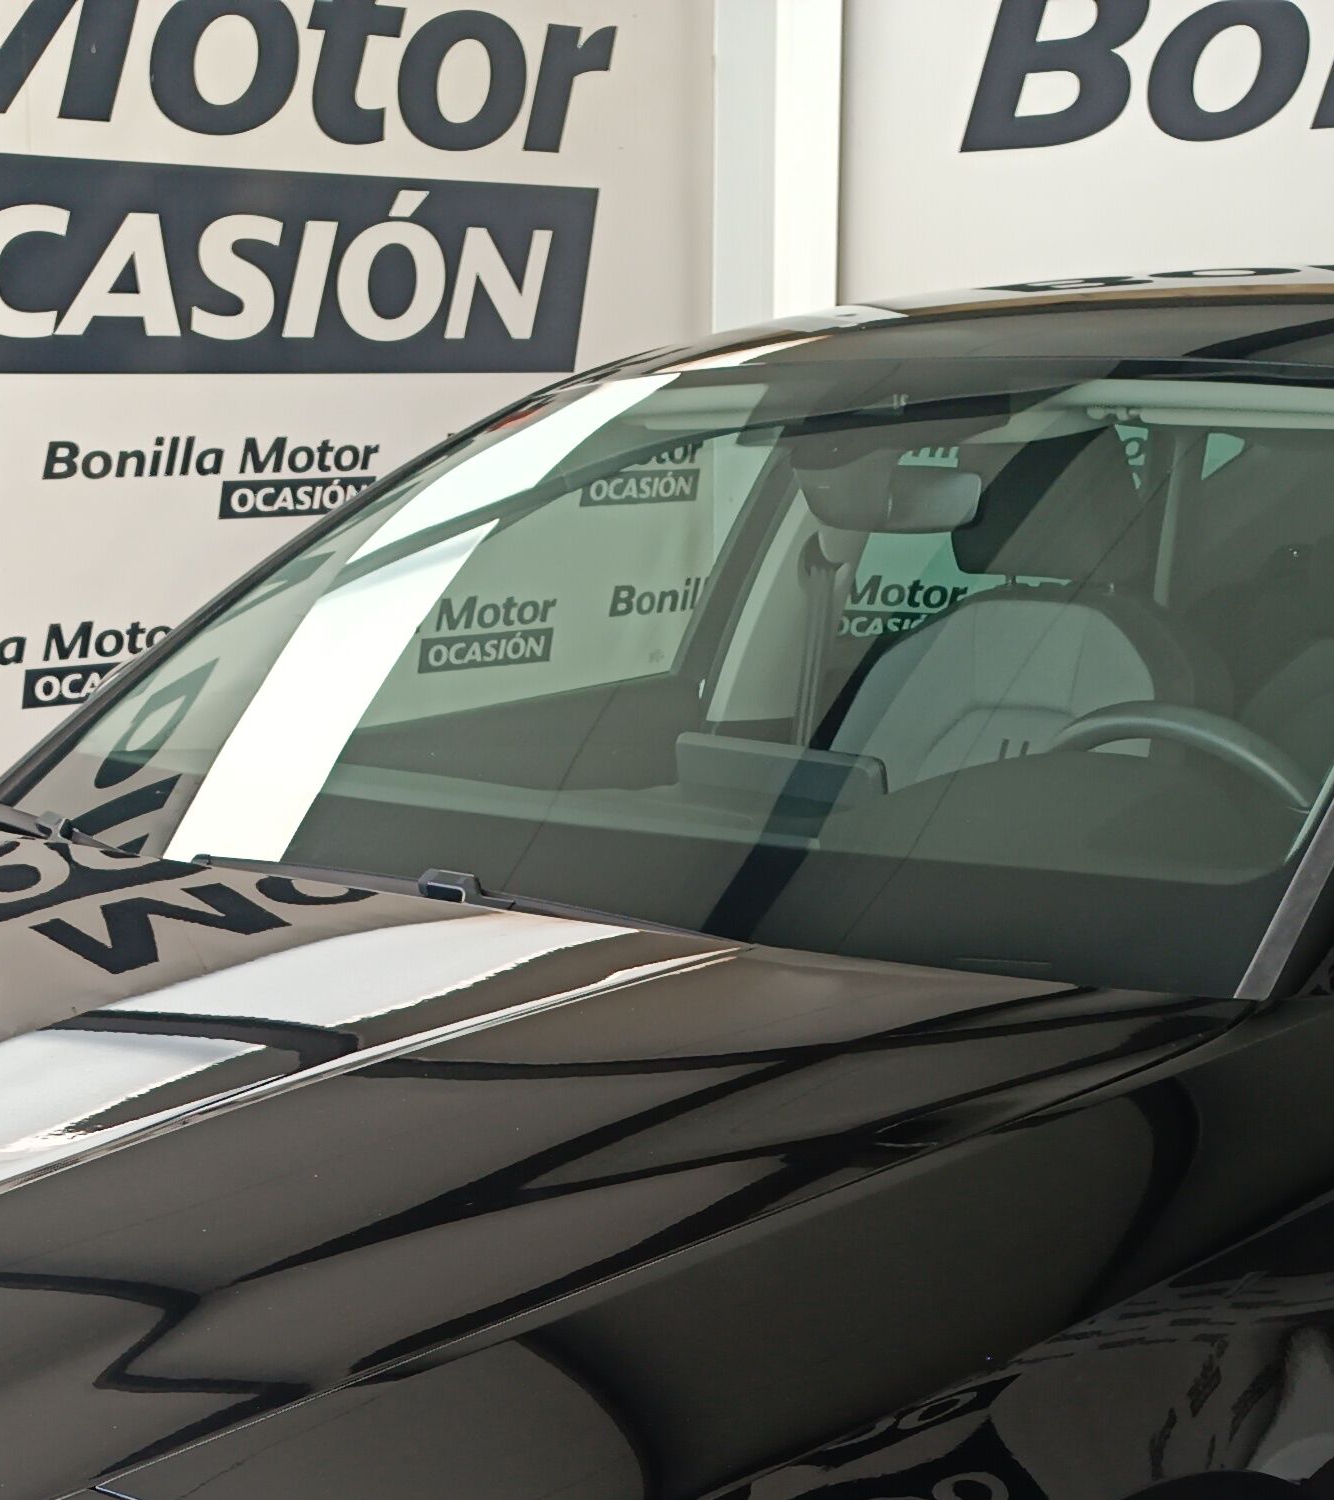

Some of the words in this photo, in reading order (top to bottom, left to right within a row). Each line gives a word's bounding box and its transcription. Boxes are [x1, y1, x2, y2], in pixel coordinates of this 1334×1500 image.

[43, 436, 224, 479] Bonilla
[239, 437, 379, 474] Motor
[589, 471, 693, 500] OCASIÓN
[436, 596, 557, 633] Motor
[427, 636, 544, 666] OCASIÓN
